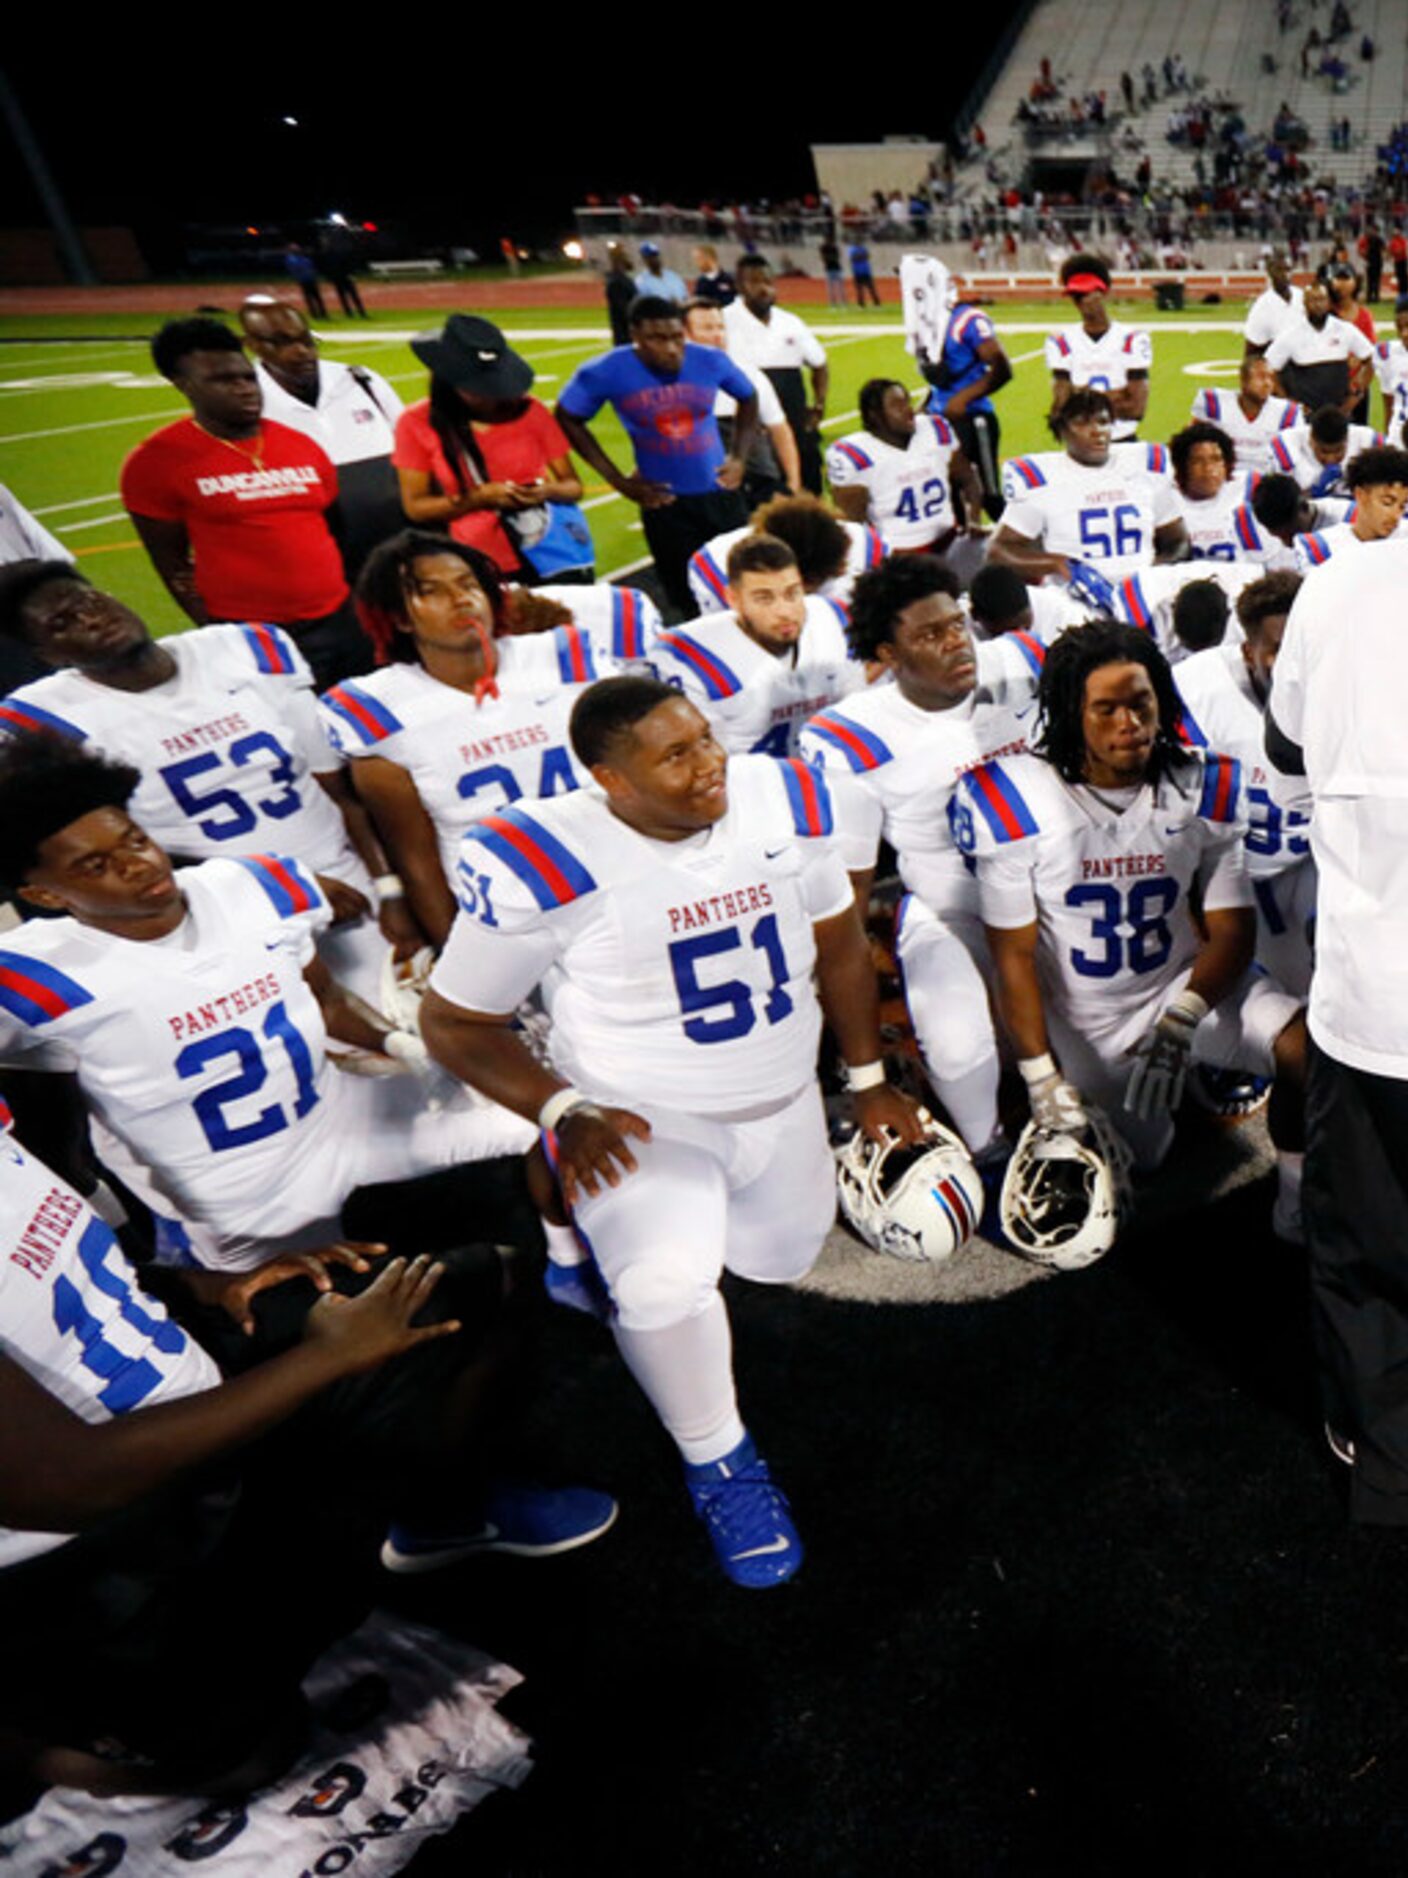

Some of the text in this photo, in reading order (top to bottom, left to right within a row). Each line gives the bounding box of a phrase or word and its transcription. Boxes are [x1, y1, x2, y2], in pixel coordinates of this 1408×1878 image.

[895, 477, 946, 522] 42
[1079, 504, 1142, 559] 56
[158, 712, 249, 758] PANTHERS
[460, 723, 549, 764] PANTHERS
[158, 730, 304, 842] 53
[456, 857, 499, 928] 51
[1082, 853, 1165, 880] PANTHERS
[667, 883, 775, 933] PANTHERS
[1064, 876, 1179, 979] 38
[168, 972, 282, 1041] PANTHERS
[667, 913, 794, 1045] 51
[173, 1000, 322, 1153] 21
[10, 1187, 84, 1281] PANTHERS
